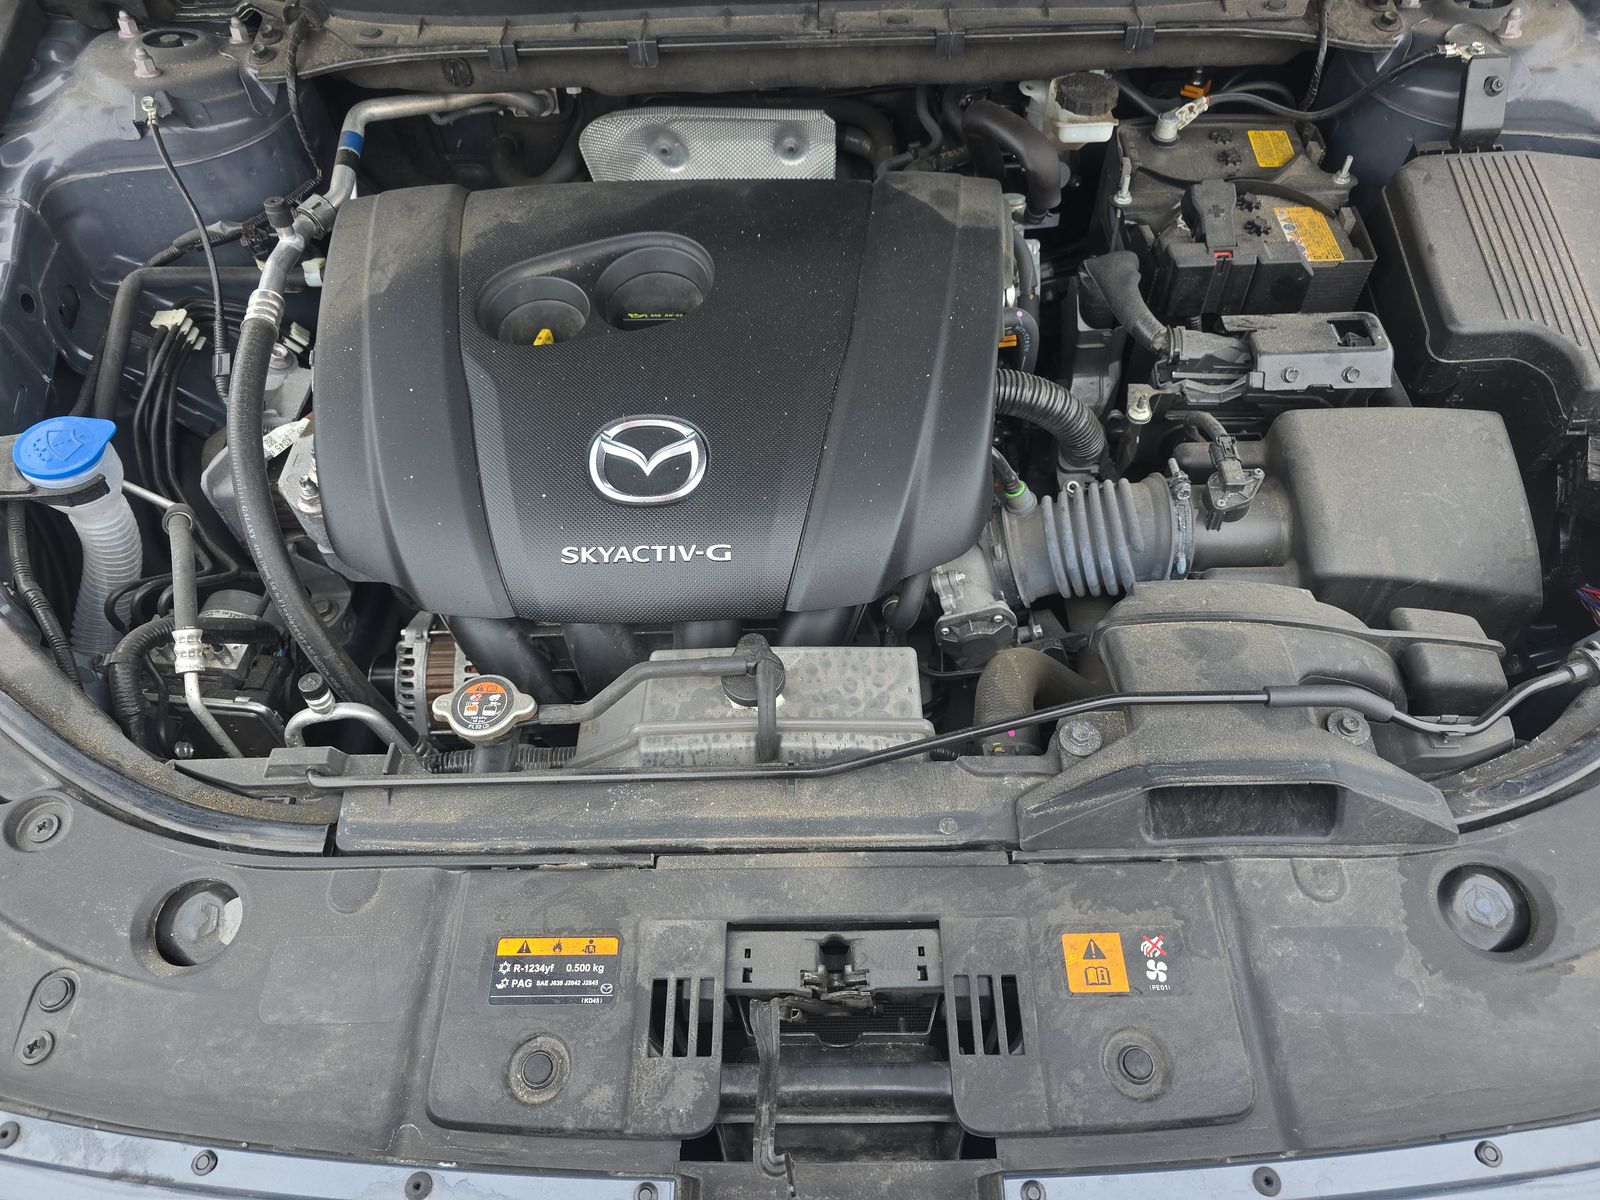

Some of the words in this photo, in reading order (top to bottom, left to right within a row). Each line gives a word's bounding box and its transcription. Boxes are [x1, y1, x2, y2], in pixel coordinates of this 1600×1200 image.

[241, 505, 257, 540] GALAXY
[561, 544, 732, 564] SKYACTIV-G
[513, 963, 555, 974] R-1234yf
[566, 963, 590, 973] 0.500
[592, 963, 605, 974] kg
[511, 979, 533, 988] PAG
